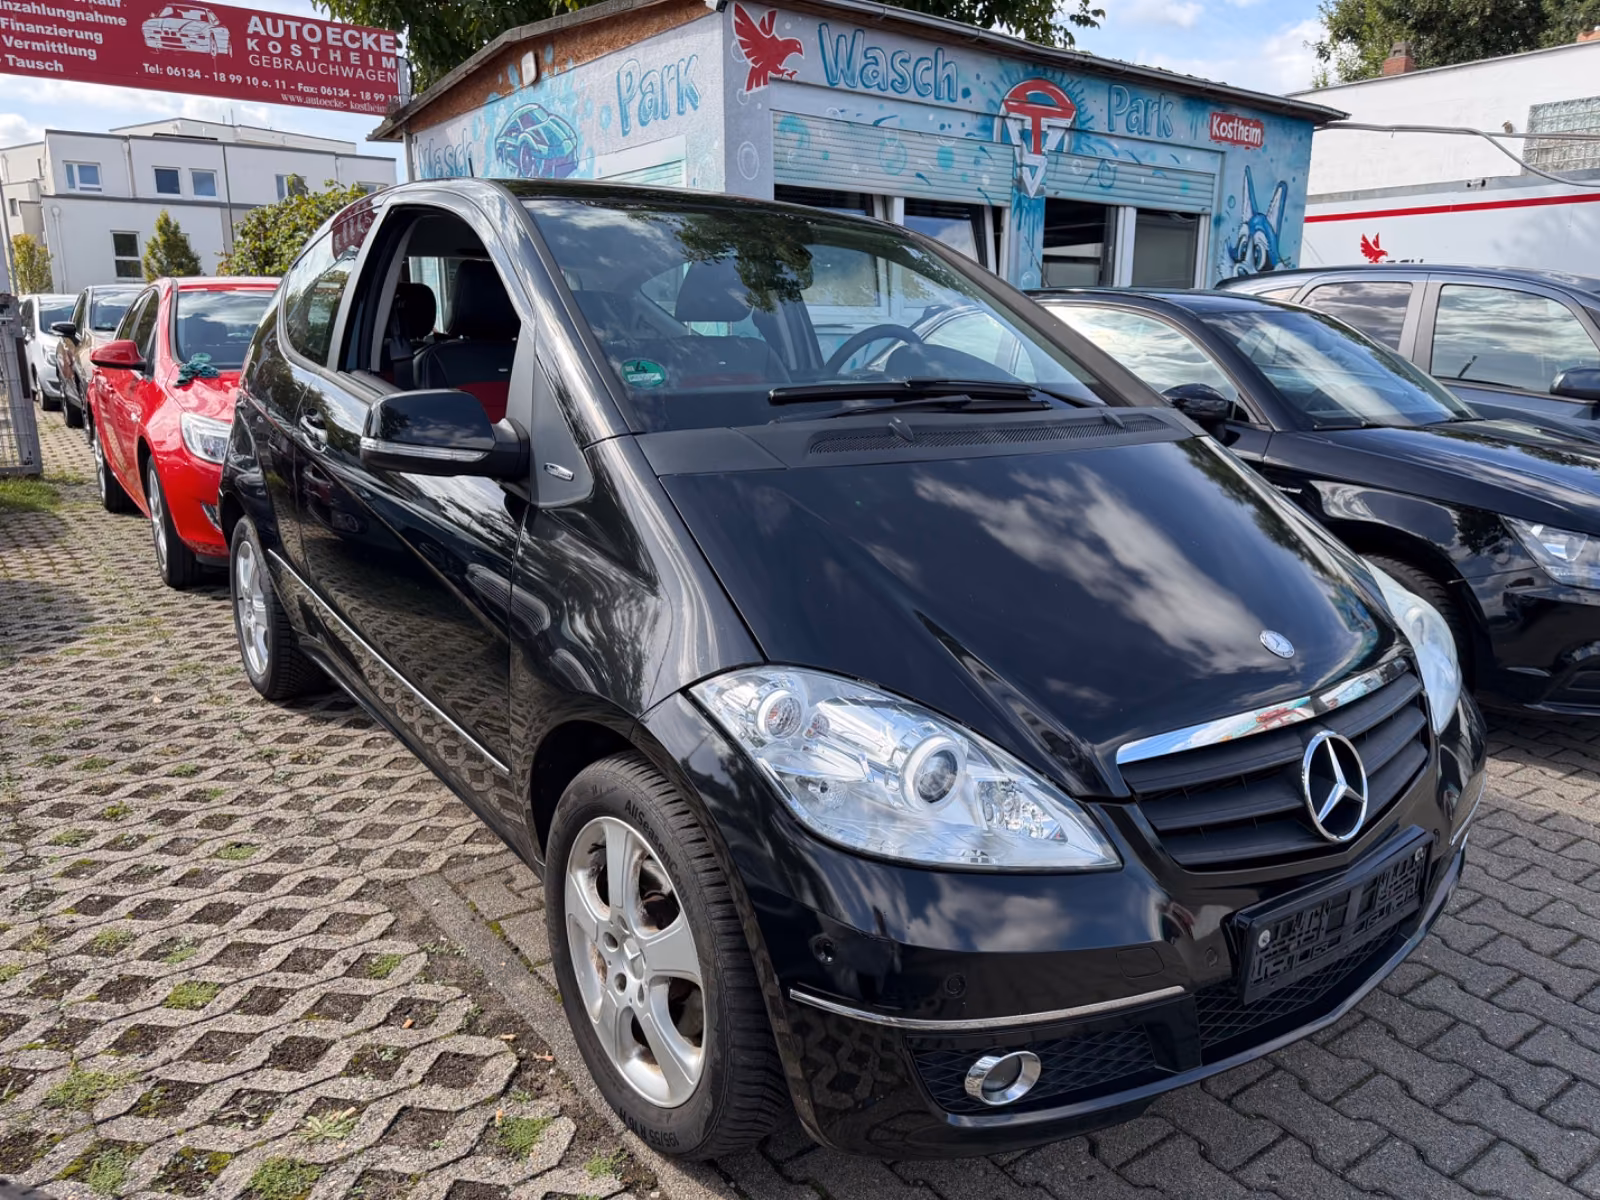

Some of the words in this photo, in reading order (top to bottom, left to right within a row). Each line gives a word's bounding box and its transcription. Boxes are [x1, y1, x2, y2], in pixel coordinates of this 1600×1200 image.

[0, 17, 103, 44] Finanzierung
[2, 34, 97, 61] Vermittlung
[4, 53, 64, 72] Tausch
[246, 38, 396, 69] KOSTHEIM
[143, 63, 163, 75] Tel:
[166, 65, 201, 79] 06134
[213, 71, 226, 82] 18
[229, 73, 242, 84] 99
[246, 76, 259, 86] 10
[274, 79, 287, 90] 11
[297, 82, 318, 94] Fax:
[320, 86, 350, 98] 06134
[360, 91, 372, 101] 18
[249, 54, 397, 83] GEBRAUCHWAGEN
[818, 21, 960, 103] Wasch
[1107, 83, 1174, 139] Park
[616, 54, 701, 138] Park
[1212, 114, 1262, 146] Kostheim
